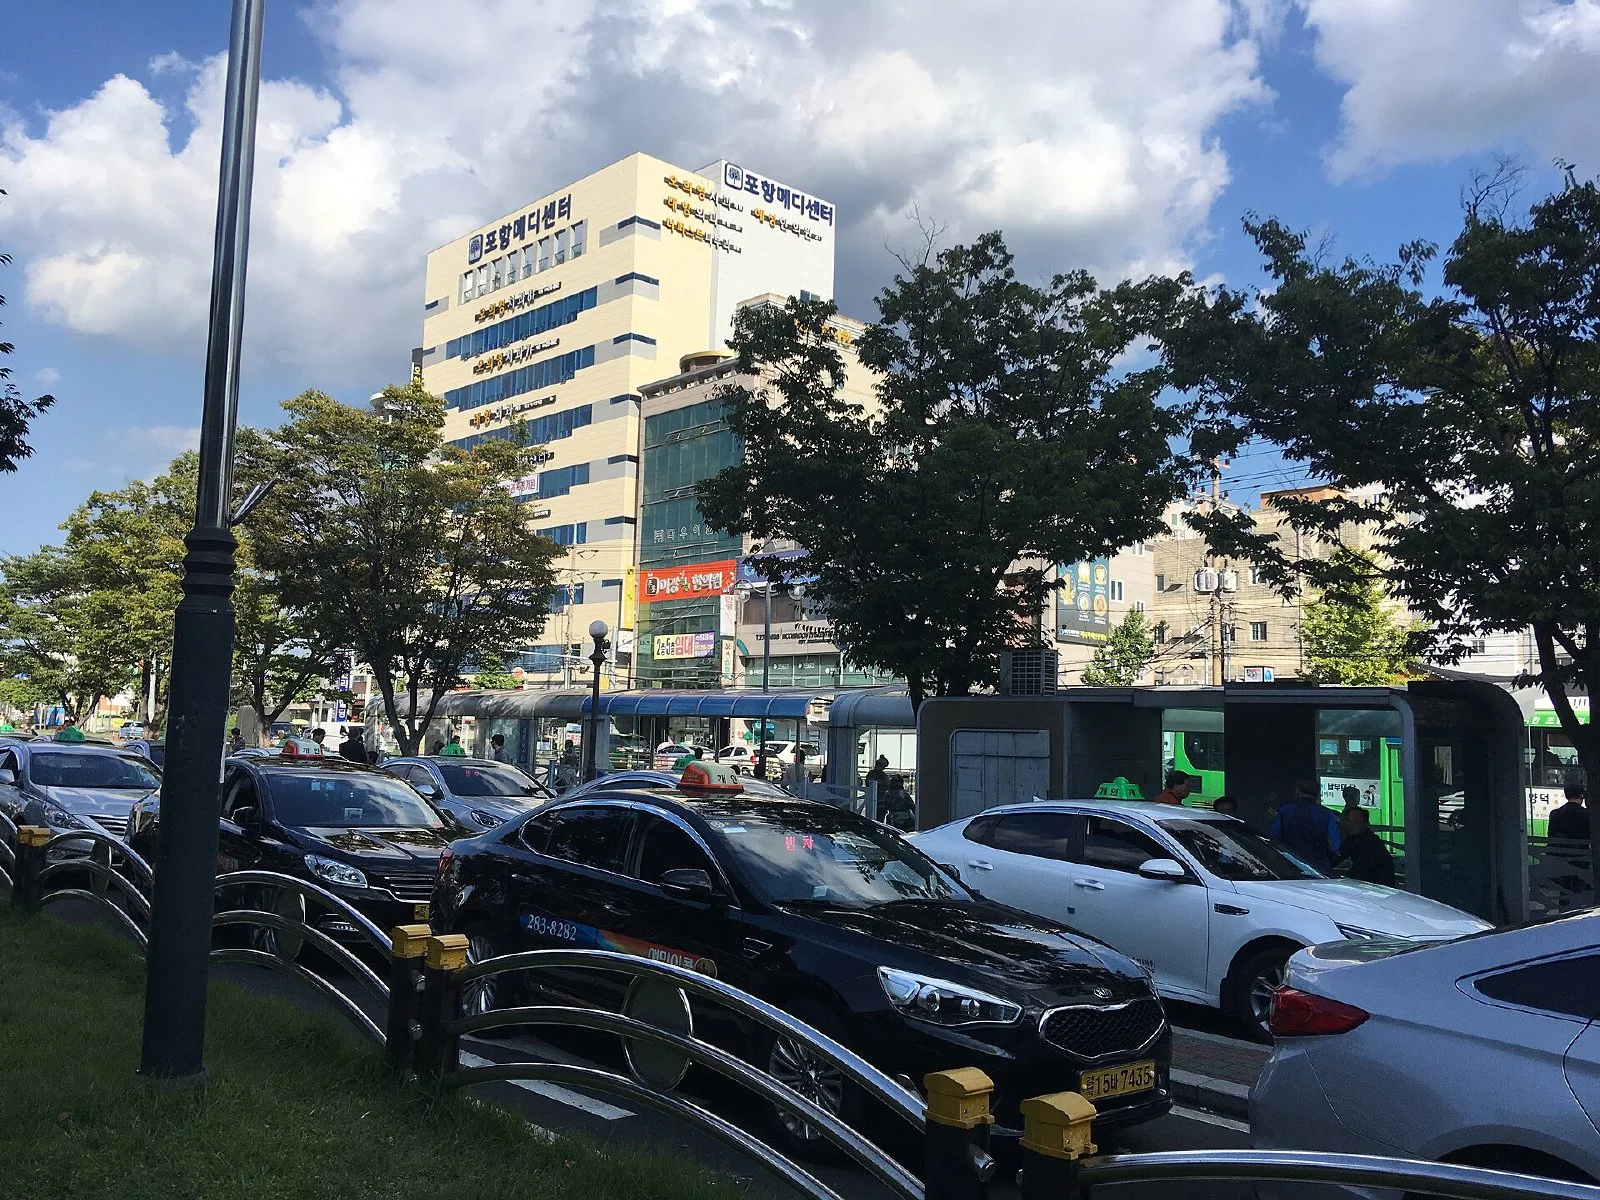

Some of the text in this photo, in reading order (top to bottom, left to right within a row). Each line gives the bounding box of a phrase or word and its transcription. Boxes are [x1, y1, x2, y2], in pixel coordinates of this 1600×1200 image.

[744, 174, 833, 227] 포항메디센터
[484, 193, 571, 255] 포항메디센터
[1528, 793, 1549, 805] 양덕
[527, 914, 577, 942] 283-8282
[1121, 1066, 1151, 1090] 7435
